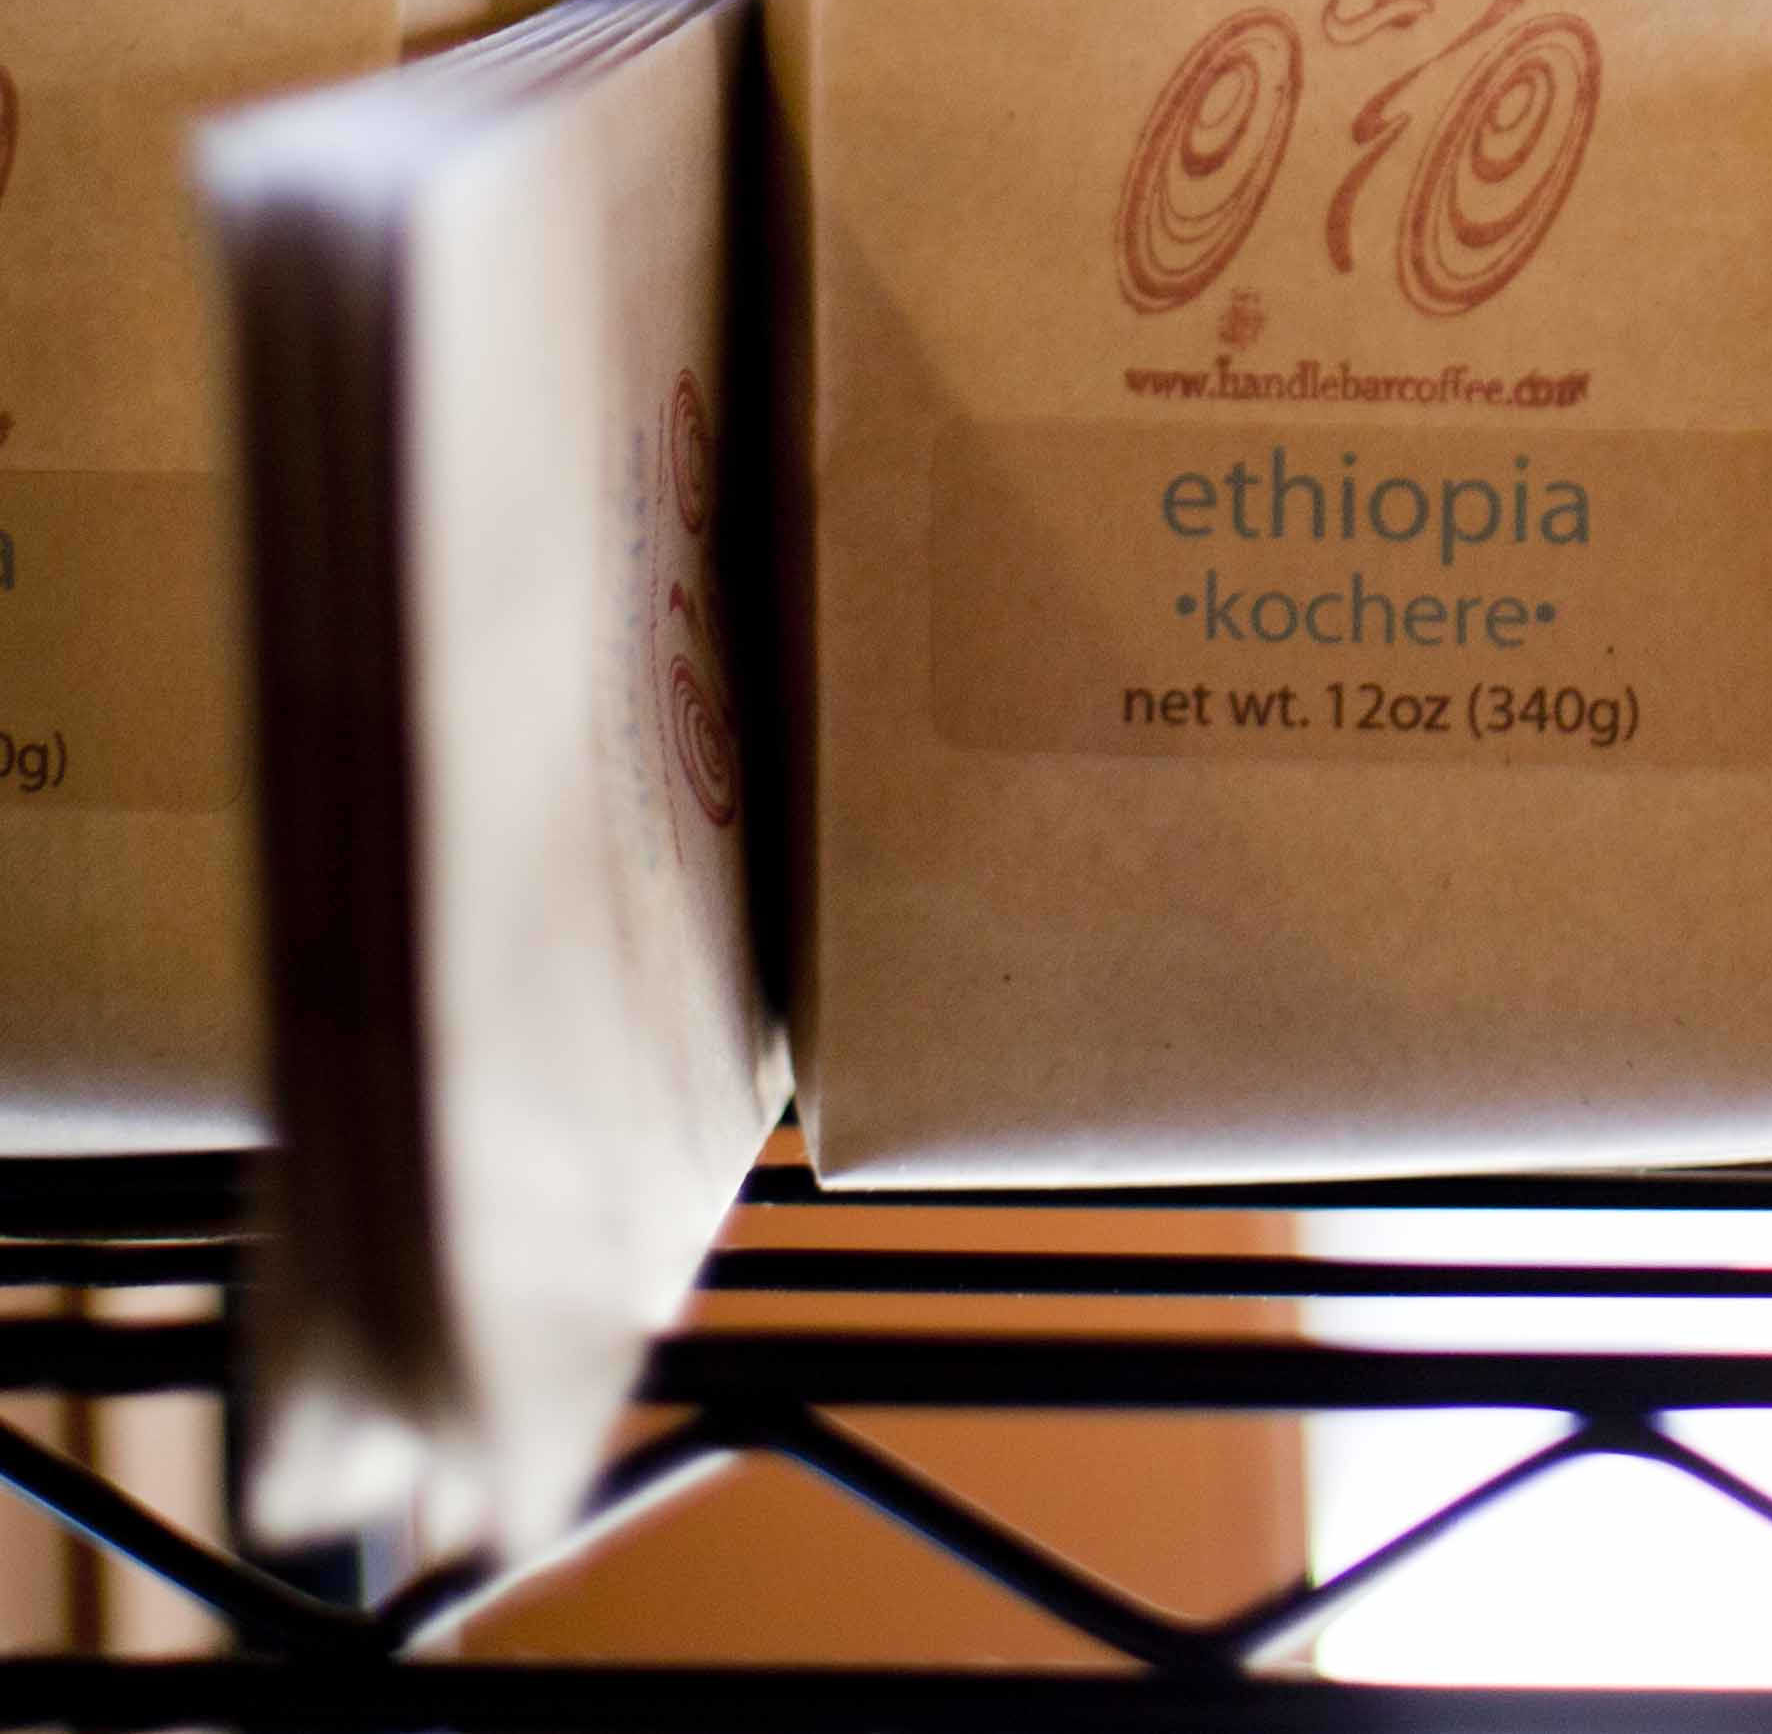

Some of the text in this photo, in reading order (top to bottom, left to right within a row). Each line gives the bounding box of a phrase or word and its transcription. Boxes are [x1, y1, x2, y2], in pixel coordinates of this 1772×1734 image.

[1161, 446, 1590, 565] ethiopia
[1123, 683, 1640, 747] net wt. 12oz (340g)
